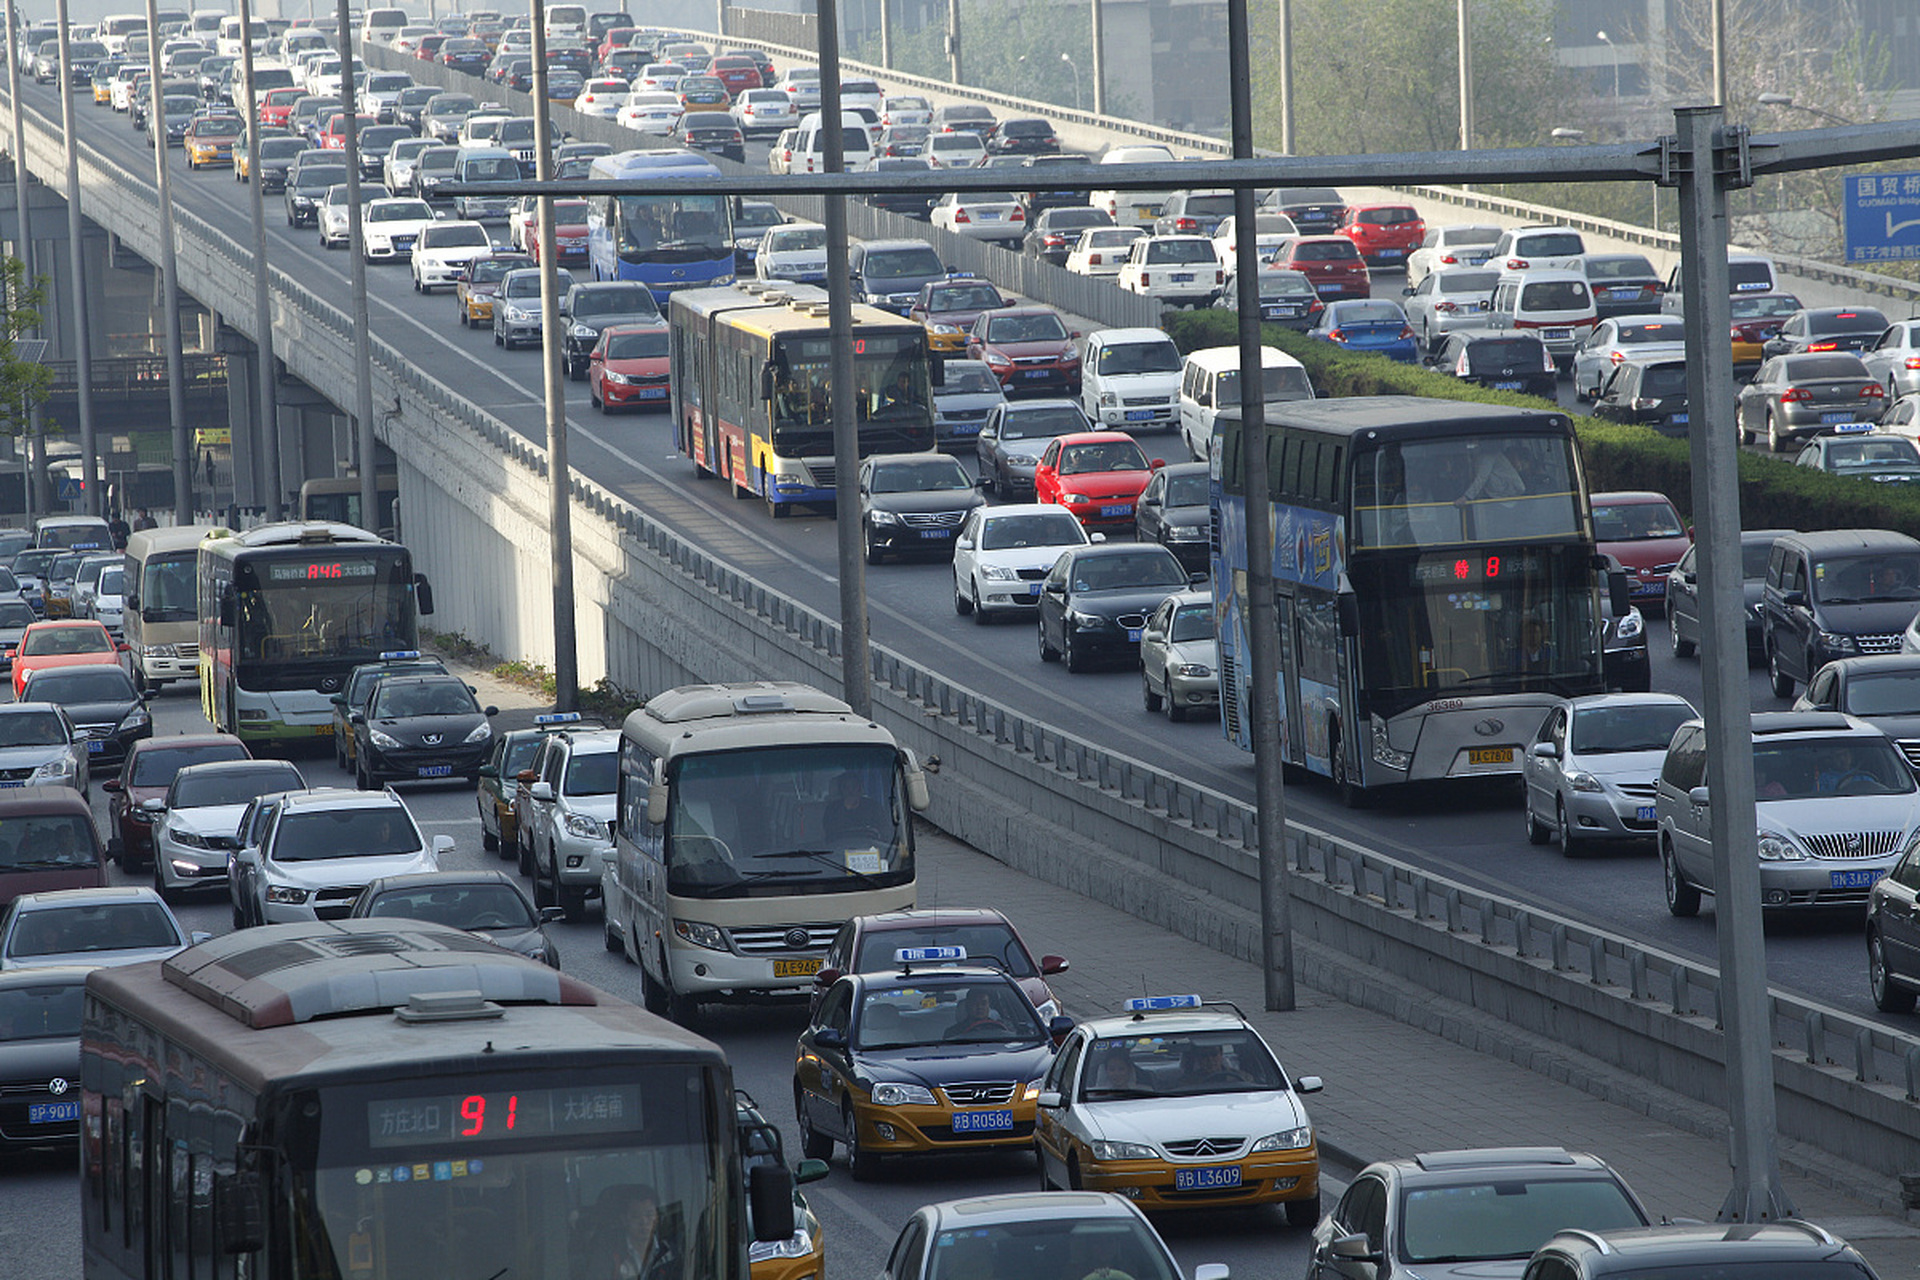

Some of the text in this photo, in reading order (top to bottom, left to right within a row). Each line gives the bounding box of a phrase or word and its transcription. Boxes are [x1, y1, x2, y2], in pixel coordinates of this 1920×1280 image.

[1857, 175, 1920, 197] 国贸桥
[1454, 559, 1470, 579] 特
[1486, 556, 1500, 577] 8
[1426, 699, 1463, 712] 36389
